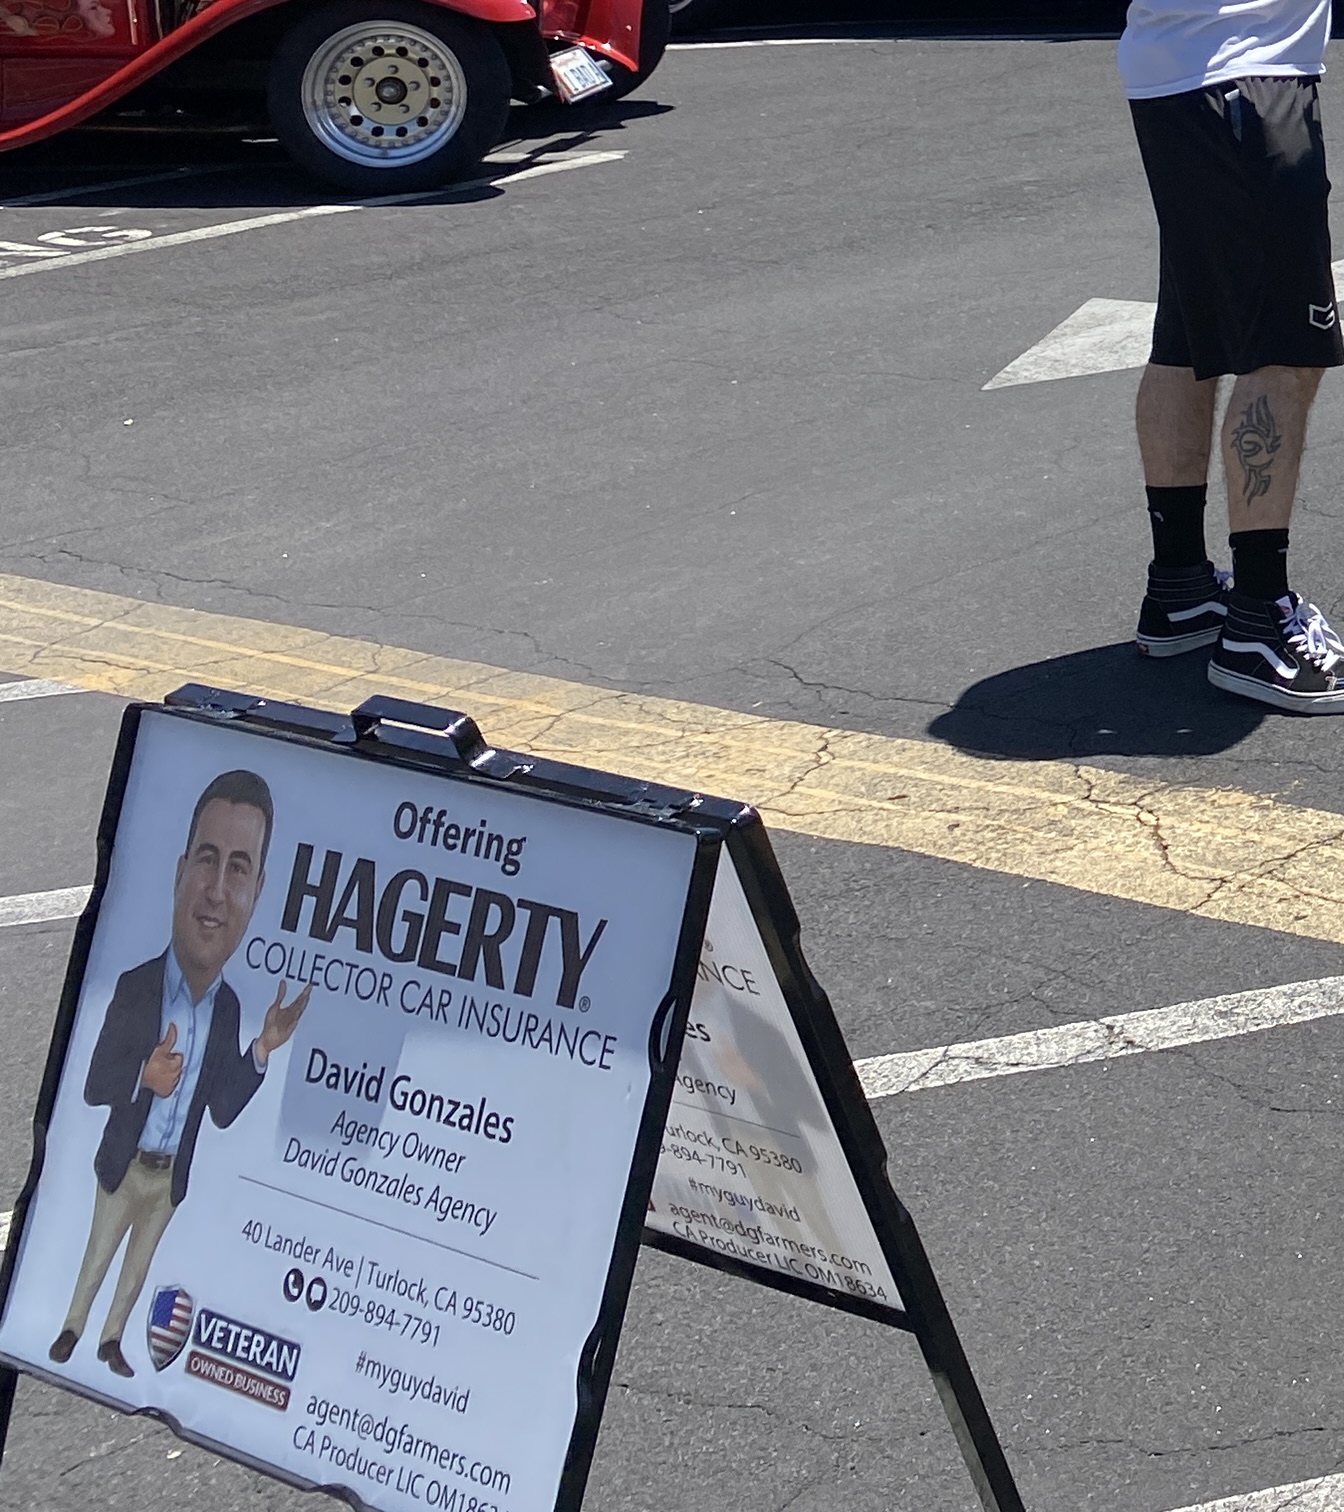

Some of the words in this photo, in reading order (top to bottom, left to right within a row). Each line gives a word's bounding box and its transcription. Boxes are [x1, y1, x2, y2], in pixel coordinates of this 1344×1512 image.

[392, 800, 528, 877] Offering
[245, 936, 393, 1008] COLLECTOR
[400, 979, 452, 1025] CAR
[458, 995, 618, 1071] INSURANCE
[305, 1047, 386, 1103] David
[389, 1074, 515, 1144] Gonzales
[330, 1109, 400, 1159] Agency
[402, 1131, 467, 1174] Owner
[722, 1137, 749, 1159] CA
[750, 1145, 803, 1175] 95380
[283, 1137, 341, 1177] David
[340, 1157, 424, 1207] Gonzales
[424, 1185, 498, 1237] Agency
[688, 1176, 802, 1223] #myguydavid
[668, 1202, 873, 1277] agent@dgfarmers.com
[672, 1220, 701, 1241] CA
[700, 1228, 773, 1265] Producer
[775, 1252, 801, 1276] LIC
[241, 1219, 263, 1244] 40
[264, 1225, 321, 1265] Lander
[321, 1246, 355, 1278] Ave
[367, 1260, 429, 1308] Turlock,
[434, 1286, 457, 1317] CA
[462, 1297, 516, 1336] 95380
[198, 1313, 299, 1377] VETERAN
[328, 1287, 441, 1347] 209-894-7791
[190, 1355, 234, 1386] OWNED
[233, 1369, 287, 1407] BUSINESS
[354, 1350, 471, 1414] #myguydavid
[292, 1425, 316, 1457] CA
[318, 1434, 395, 1487] Producer
[395, 1465, 426, 1502] LIC
[426, 1480, 510, 1512] OM18
[305, 1392, 511, 1495] agent@dgfarmers.com
